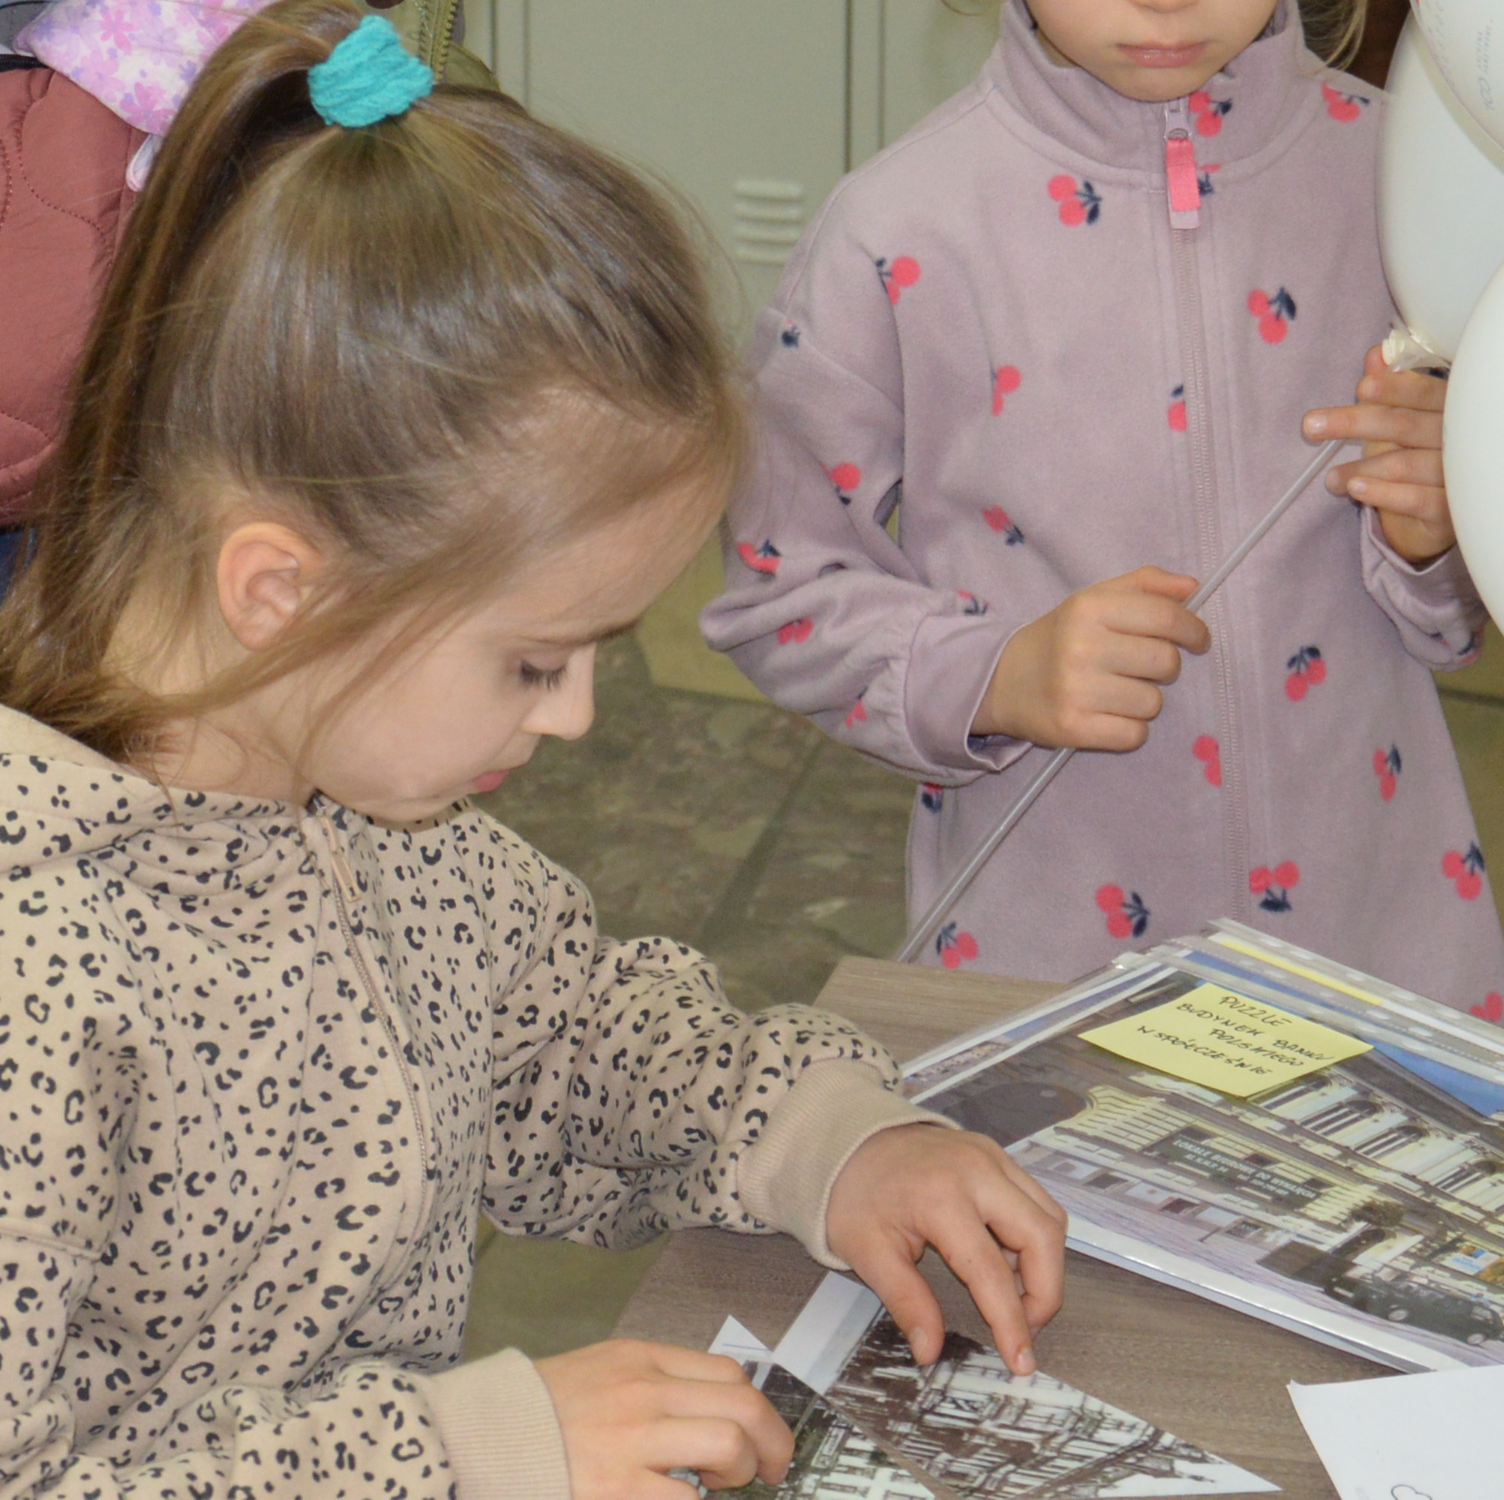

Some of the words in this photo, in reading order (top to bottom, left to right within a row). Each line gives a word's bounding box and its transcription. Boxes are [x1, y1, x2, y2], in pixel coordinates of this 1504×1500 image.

[1220, 995, 1293, 1028] PUZZLE
[1176, 1003, 1266, 1037] BUDYNEK
[1272, 1038, 1336, 1062] BANKU
[1209, 1027, 1305, 1067] POLSKIEGO
